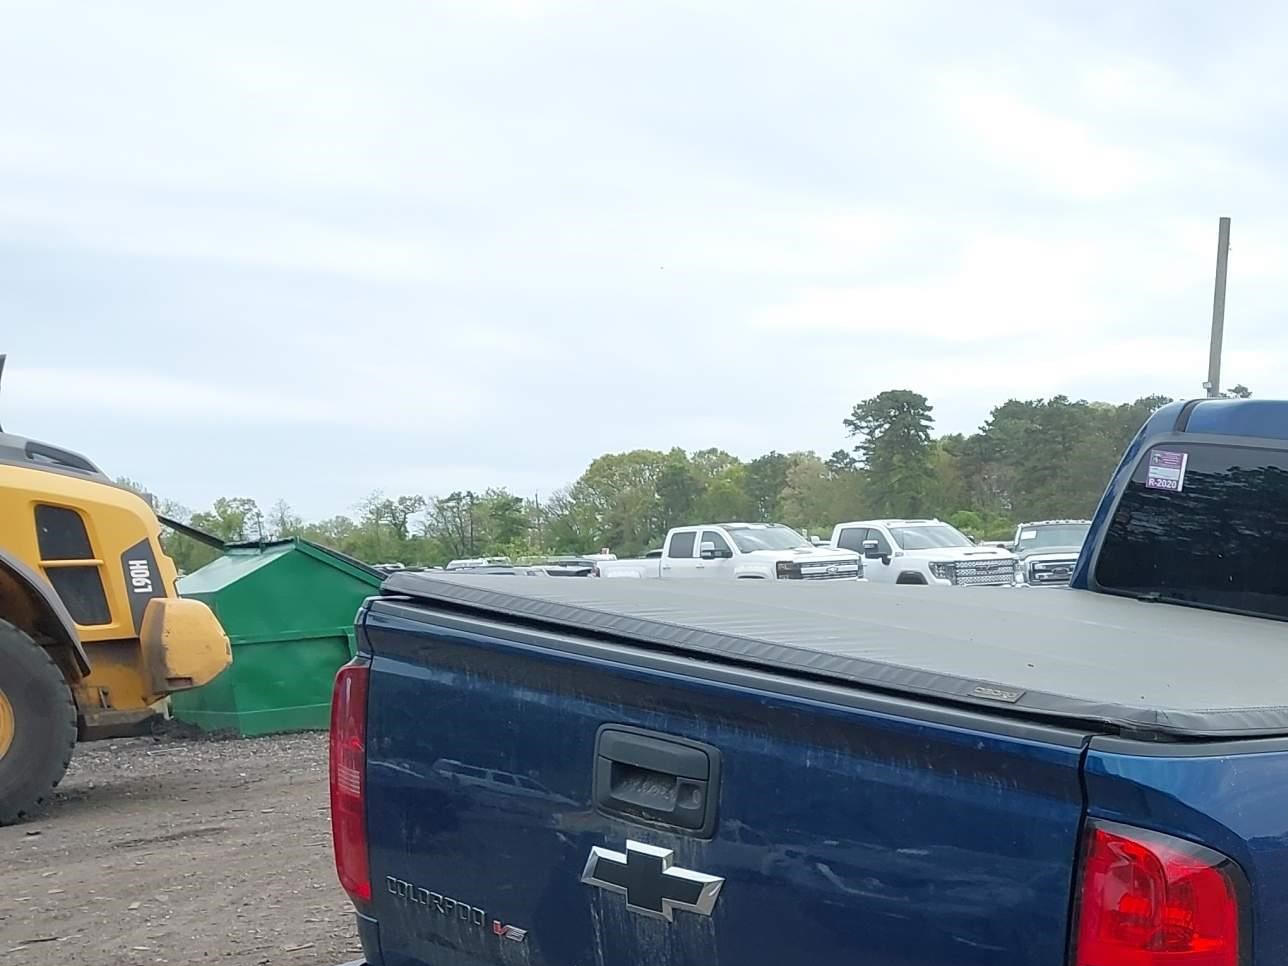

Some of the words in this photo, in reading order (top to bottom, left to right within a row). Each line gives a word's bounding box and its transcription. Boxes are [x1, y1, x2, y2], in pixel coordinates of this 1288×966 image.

[1148, 478, 1177, 489] R-2020
[128, 559, 153, 593] L90H
[386, 875, 486, 927] COLORADO
